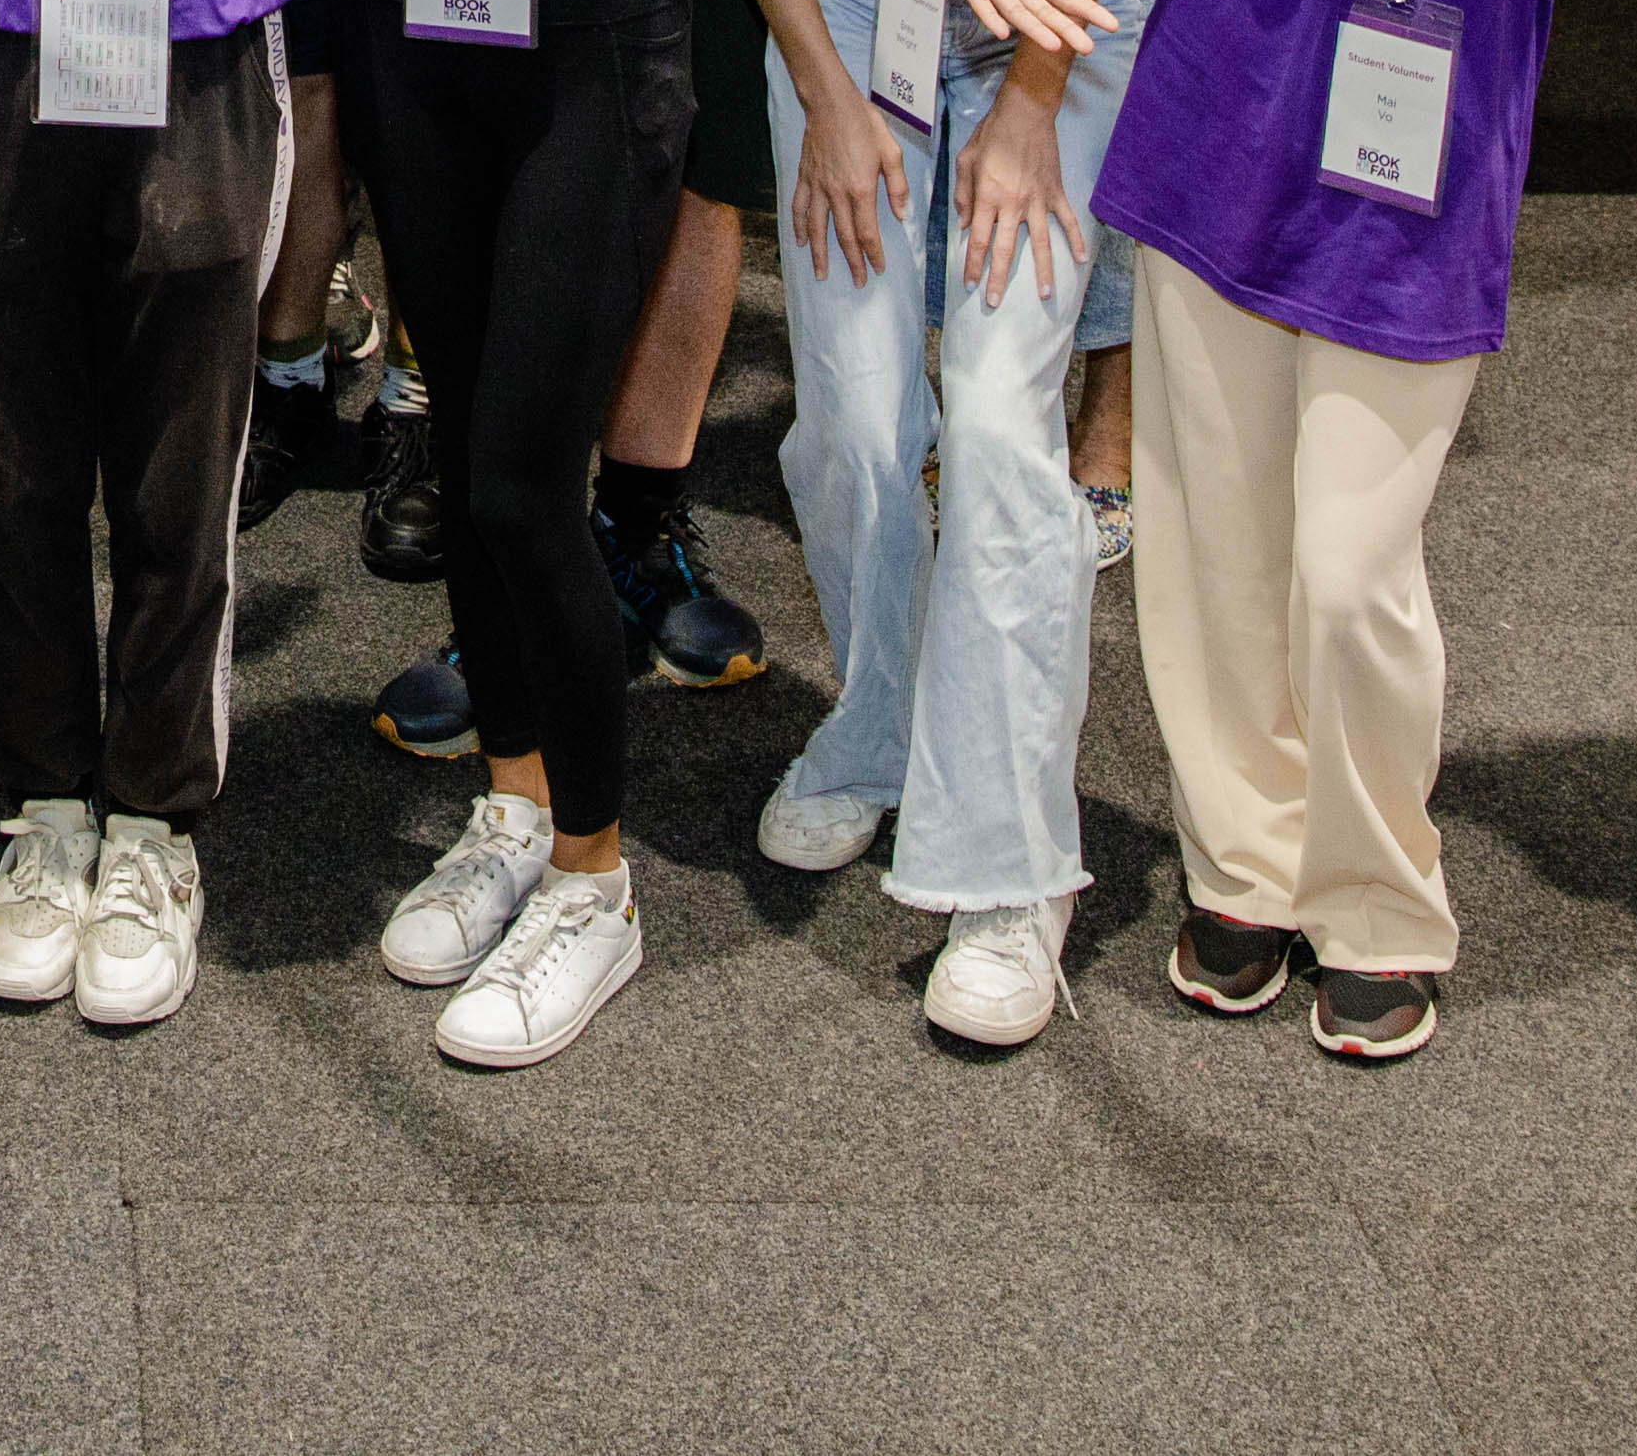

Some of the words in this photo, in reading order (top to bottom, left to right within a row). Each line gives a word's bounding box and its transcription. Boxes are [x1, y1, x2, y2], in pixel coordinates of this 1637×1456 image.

[459, 9, 491, 25] FAIR
[1347, 51, 1386, 72] Student
[1388, 62, 1435, 84] Volunteer
[890, 71, 915, 91] BOOK
[896, 89, 915, 106] FAIR
[1377, 93, 1398, 109] Mai
[1377, 109, 1393, 123] Vo
[1357, 147, 1400, 171] BOOK
[1370, 163, 1400, 183] FAIR
